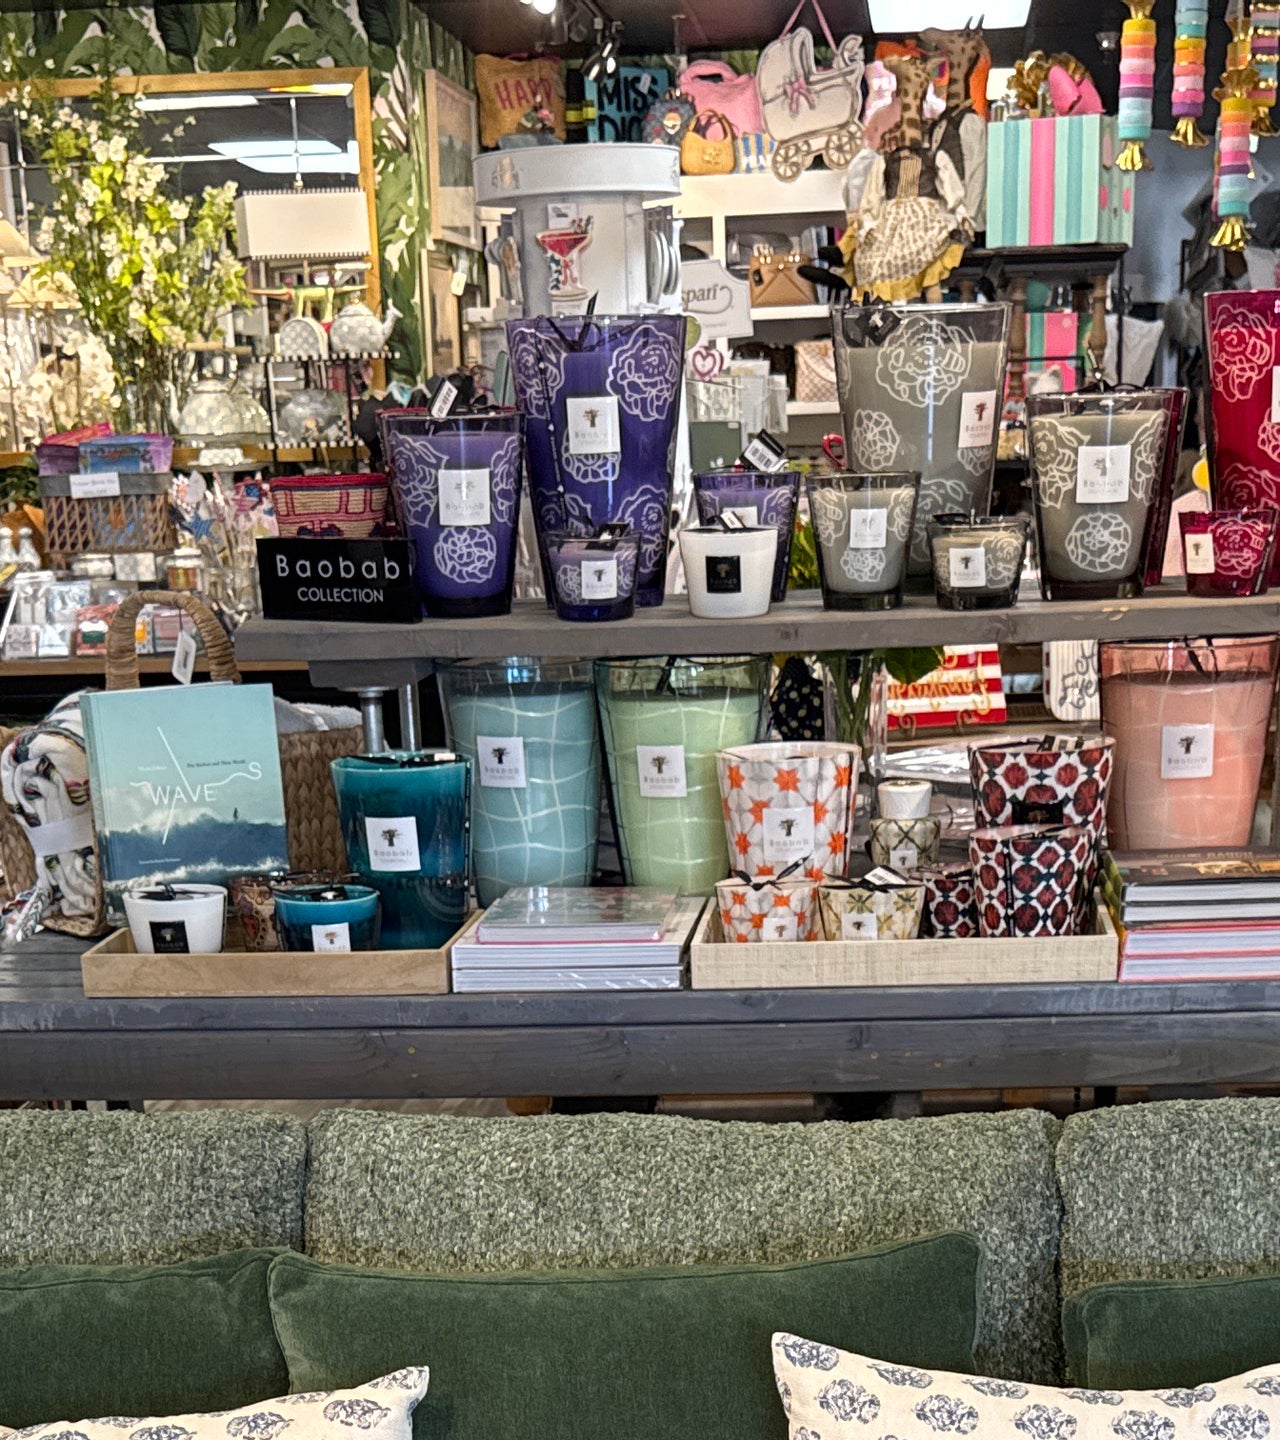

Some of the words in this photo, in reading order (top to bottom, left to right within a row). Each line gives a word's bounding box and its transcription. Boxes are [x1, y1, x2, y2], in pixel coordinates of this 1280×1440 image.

[597, 75, 659, 113] MISS
[275, 554, 400, 579] Baobab
[297, 587, 384, 603] COLLECTION
